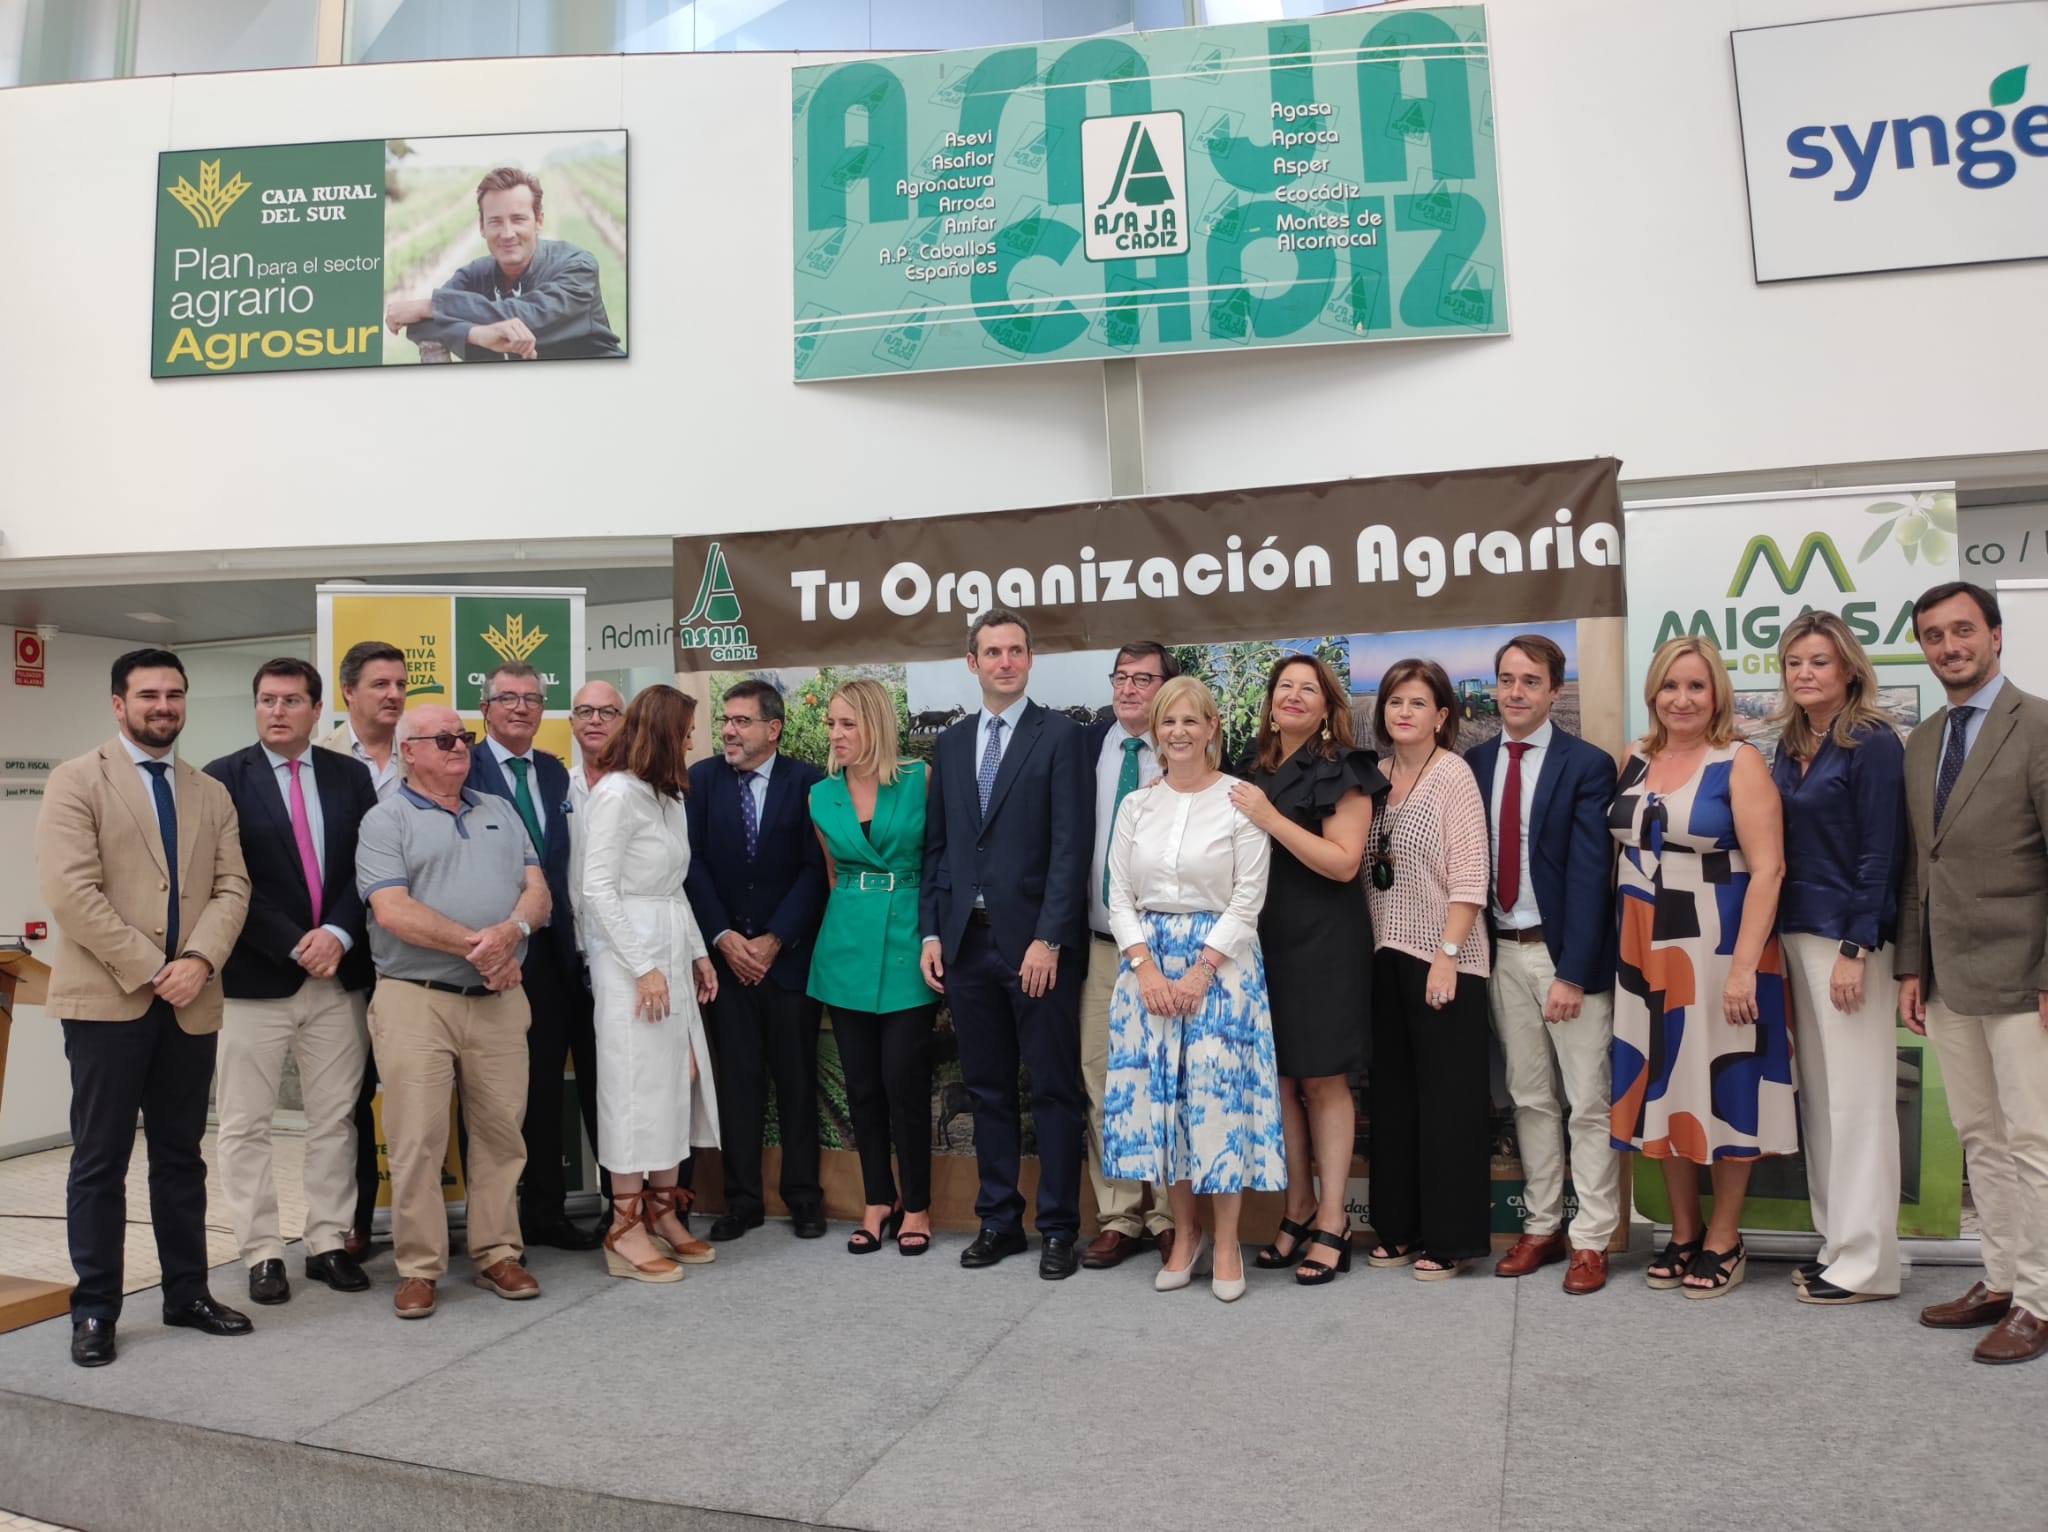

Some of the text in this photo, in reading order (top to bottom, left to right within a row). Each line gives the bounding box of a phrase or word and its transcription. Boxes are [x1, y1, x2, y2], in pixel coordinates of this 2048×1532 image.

[1271, 101, 1332, 121] Agasa
[945, 130, 992, 147] Asevi
[1272, 129, 1339, 148] Aproca
[932, 152, 994, 170] Asaflor
[1786, 104, 2048, 201] synge
[1274, 156, 1330, 176] Asper
[261, 184, 377, 205] CAJA RURAL
[896, 175, 995, 199] Agronatura
[1275, 181, 1360, 203] Ecocádiz
[261, 206, 346, 224] DEL SUR
[939, 196, 995, 213] Arroca
[945, 215, 996, 234] Amfar
[1094, 208, 1176, 235] ASAJA
[1276, 210, 1382, 231] Montes de
[1115, 231, 1178, 250] CADIZ
[1278, 229, 1377, 251] Alcornocal
[880, 245, 913, 264] A.P.
[919, 240, 997, 260] Caballos
[175, 248, 381, 282] Plan para el sector
[905, 260, 998, 282] Españoles
[170, 278, 314, 327] agrario
[166, 325, 379, 371] Agrosur
[790, 507, 1621, 627] Tu Organización Agraria
[420, 635, 435, 646] TU
[680, 625, 749, 649] ASAJA
